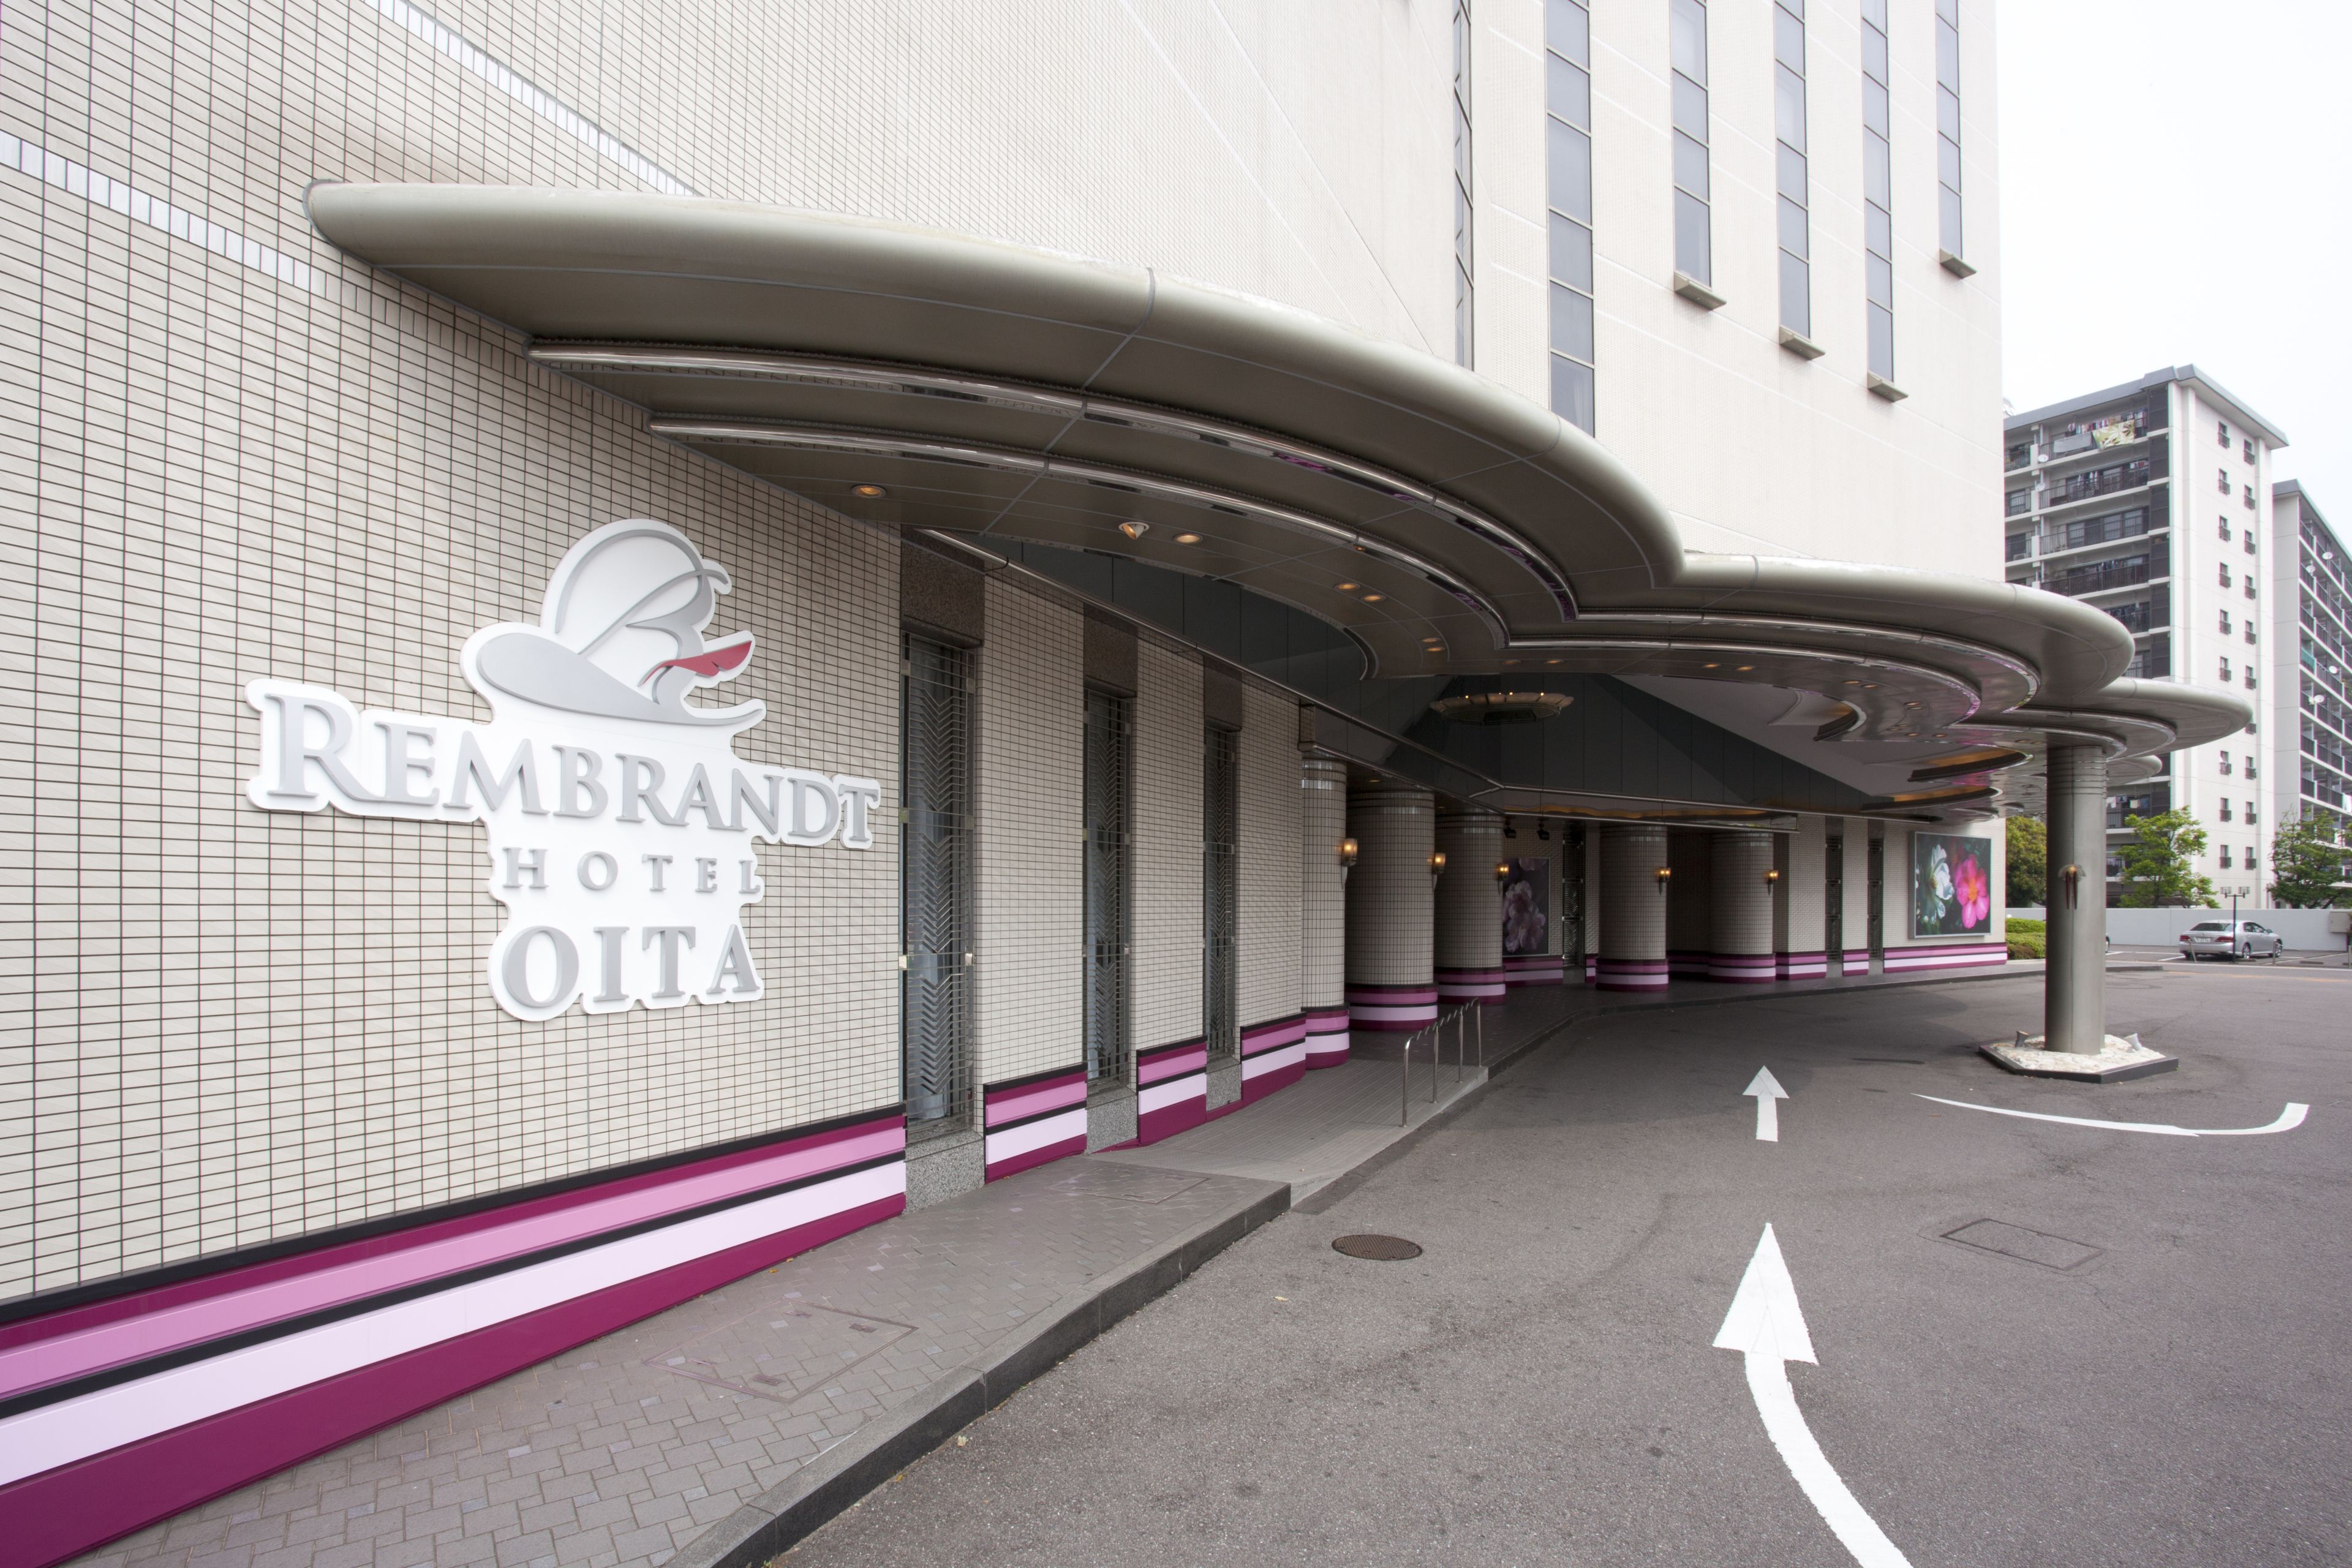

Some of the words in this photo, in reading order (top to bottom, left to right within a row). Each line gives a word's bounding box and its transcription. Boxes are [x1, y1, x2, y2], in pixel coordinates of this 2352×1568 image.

[263, 692, 879, 842] REMBRANDT
[502, 846, 760, 894] HOTEL
[502, 924, 760, 1008] OITA
